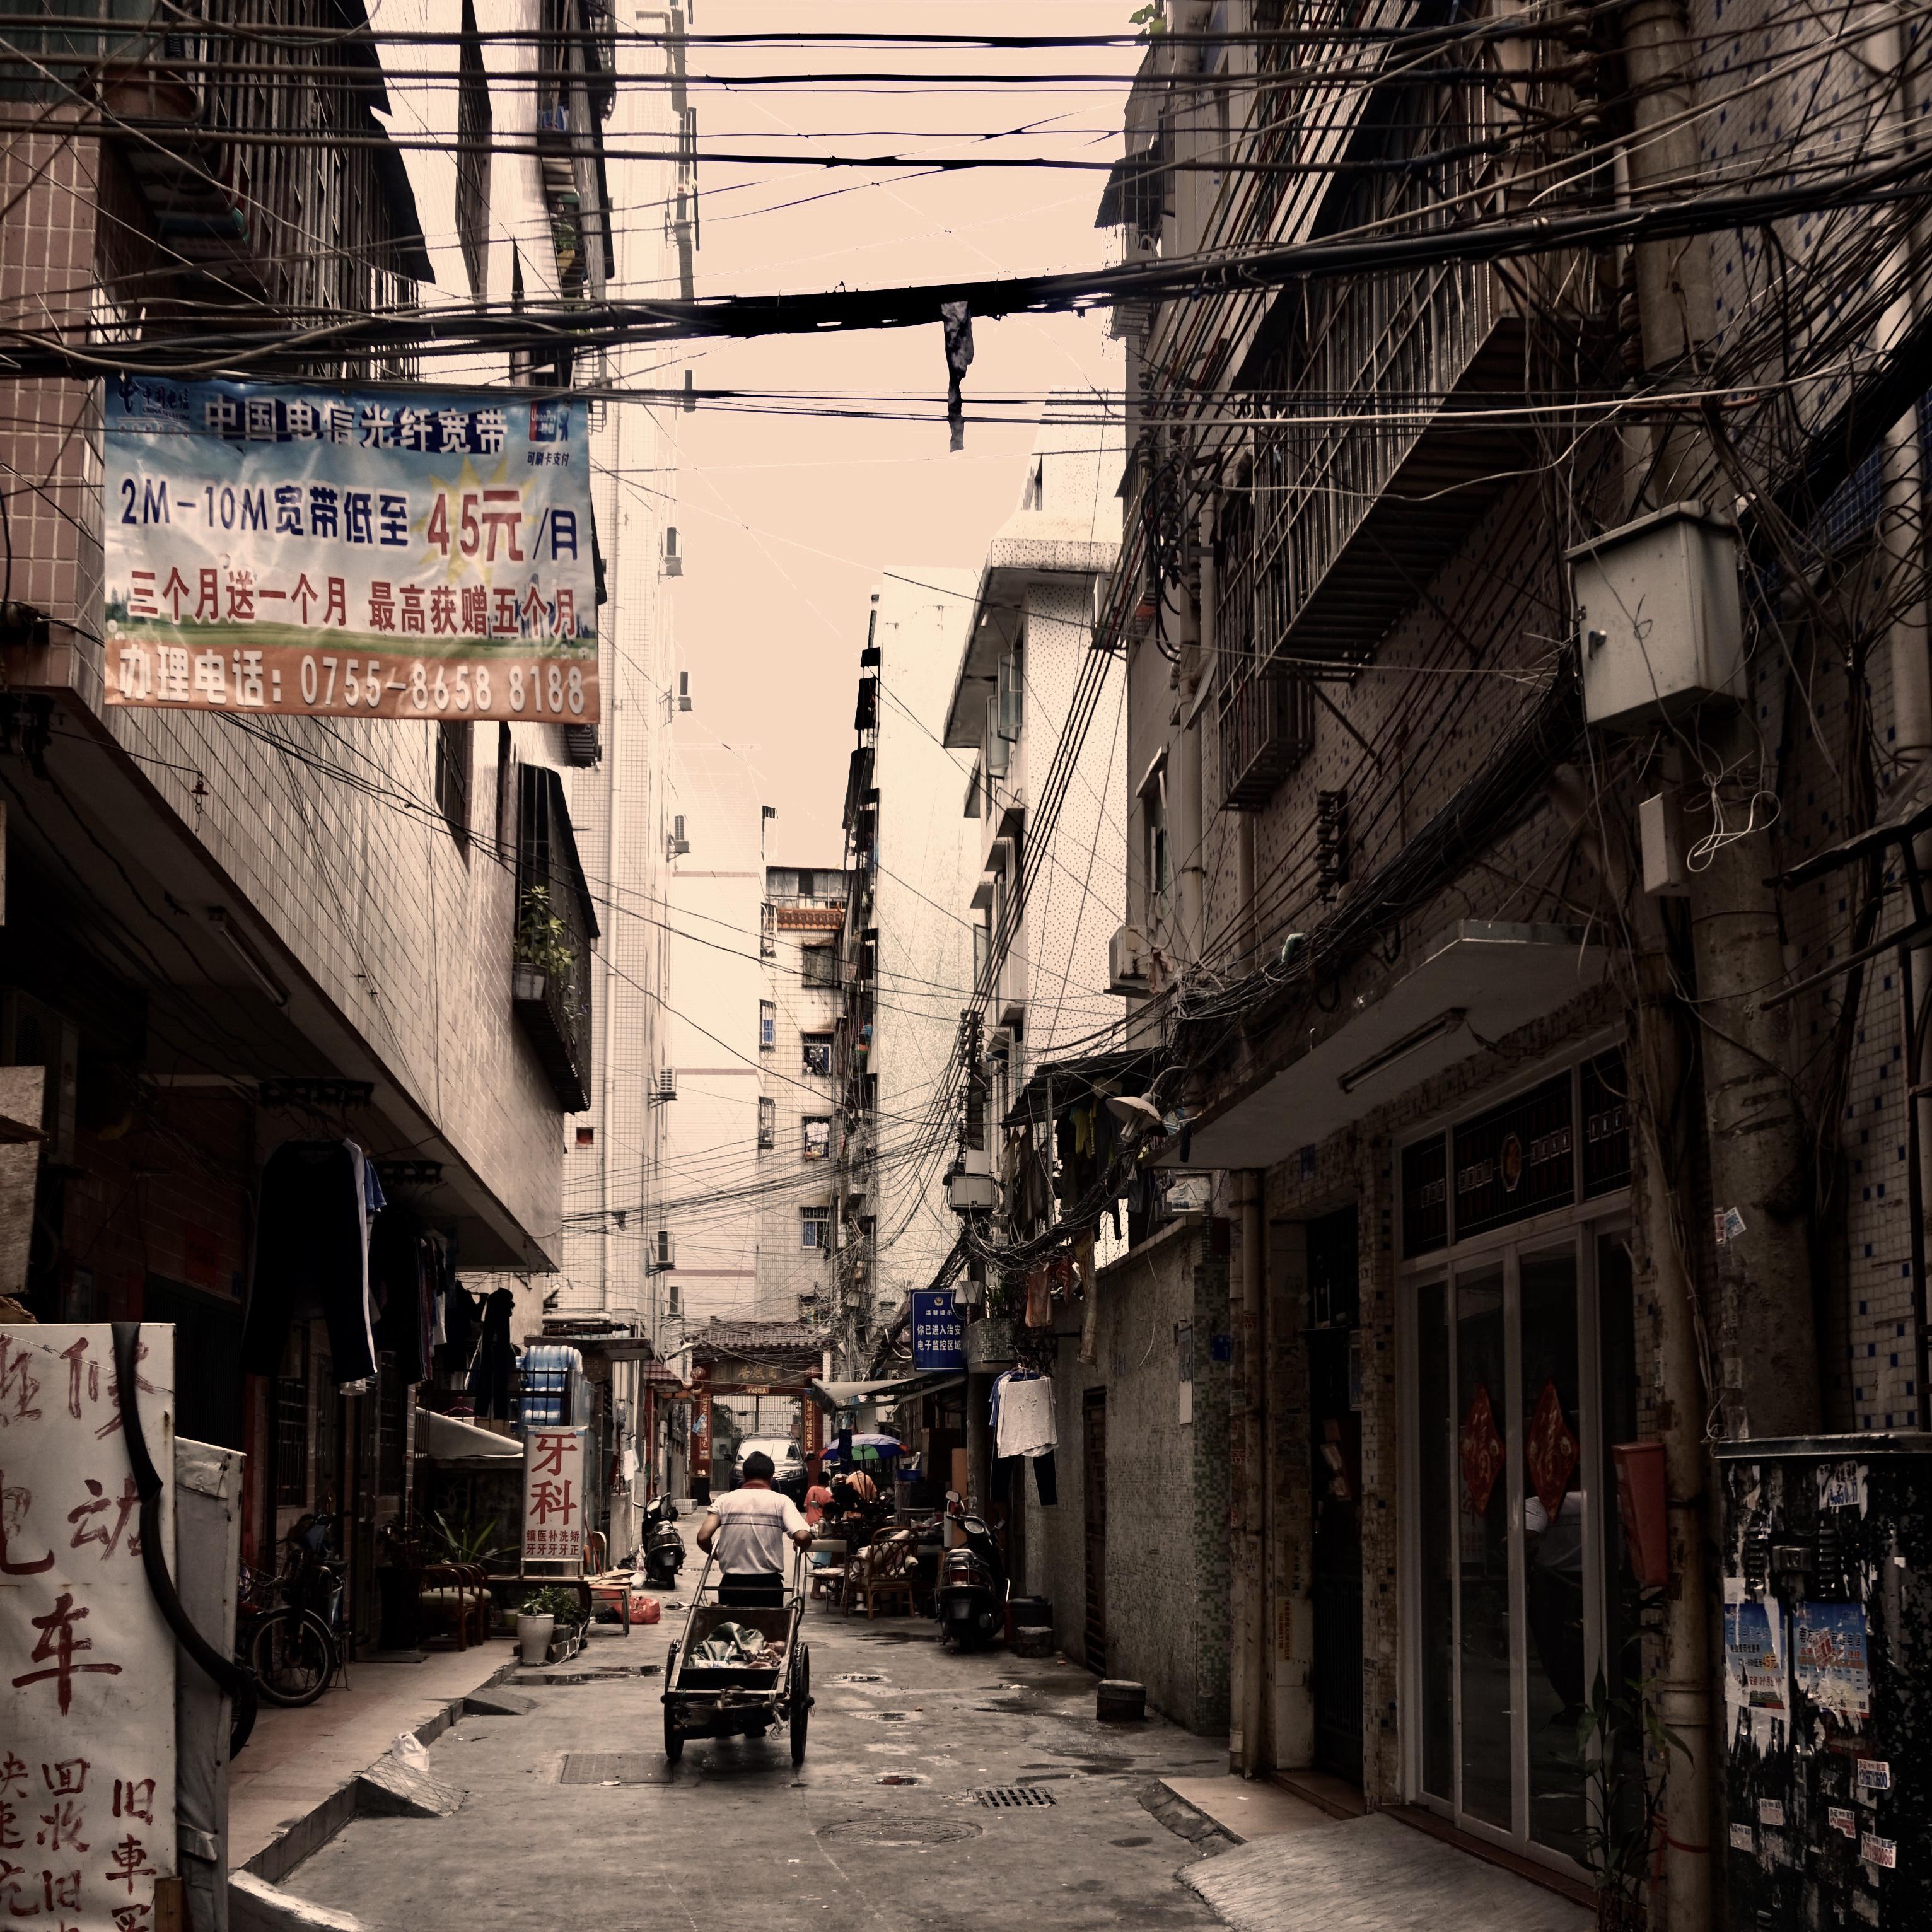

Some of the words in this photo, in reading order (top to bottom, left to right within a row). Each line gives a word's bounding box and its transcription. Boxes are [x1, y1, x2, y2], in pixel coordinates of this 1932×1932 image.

[205, 393, 508, 455] 中国电信光纤宽带
[527, 451, 570, 467] 可刷卡支付
[130, 566, 347, 626] 三个月送一个月
[368, 580, 575, 637] 最高获赠五个月
[301, 654, 492, 712] 0755-8658
[508, 664, 584, 714] 8188
[917, 1339, 962, 1351] 电子监控区域
[530, 1432, 578, 1526] 牙科
[12, 1592, 122, 1716] 车
